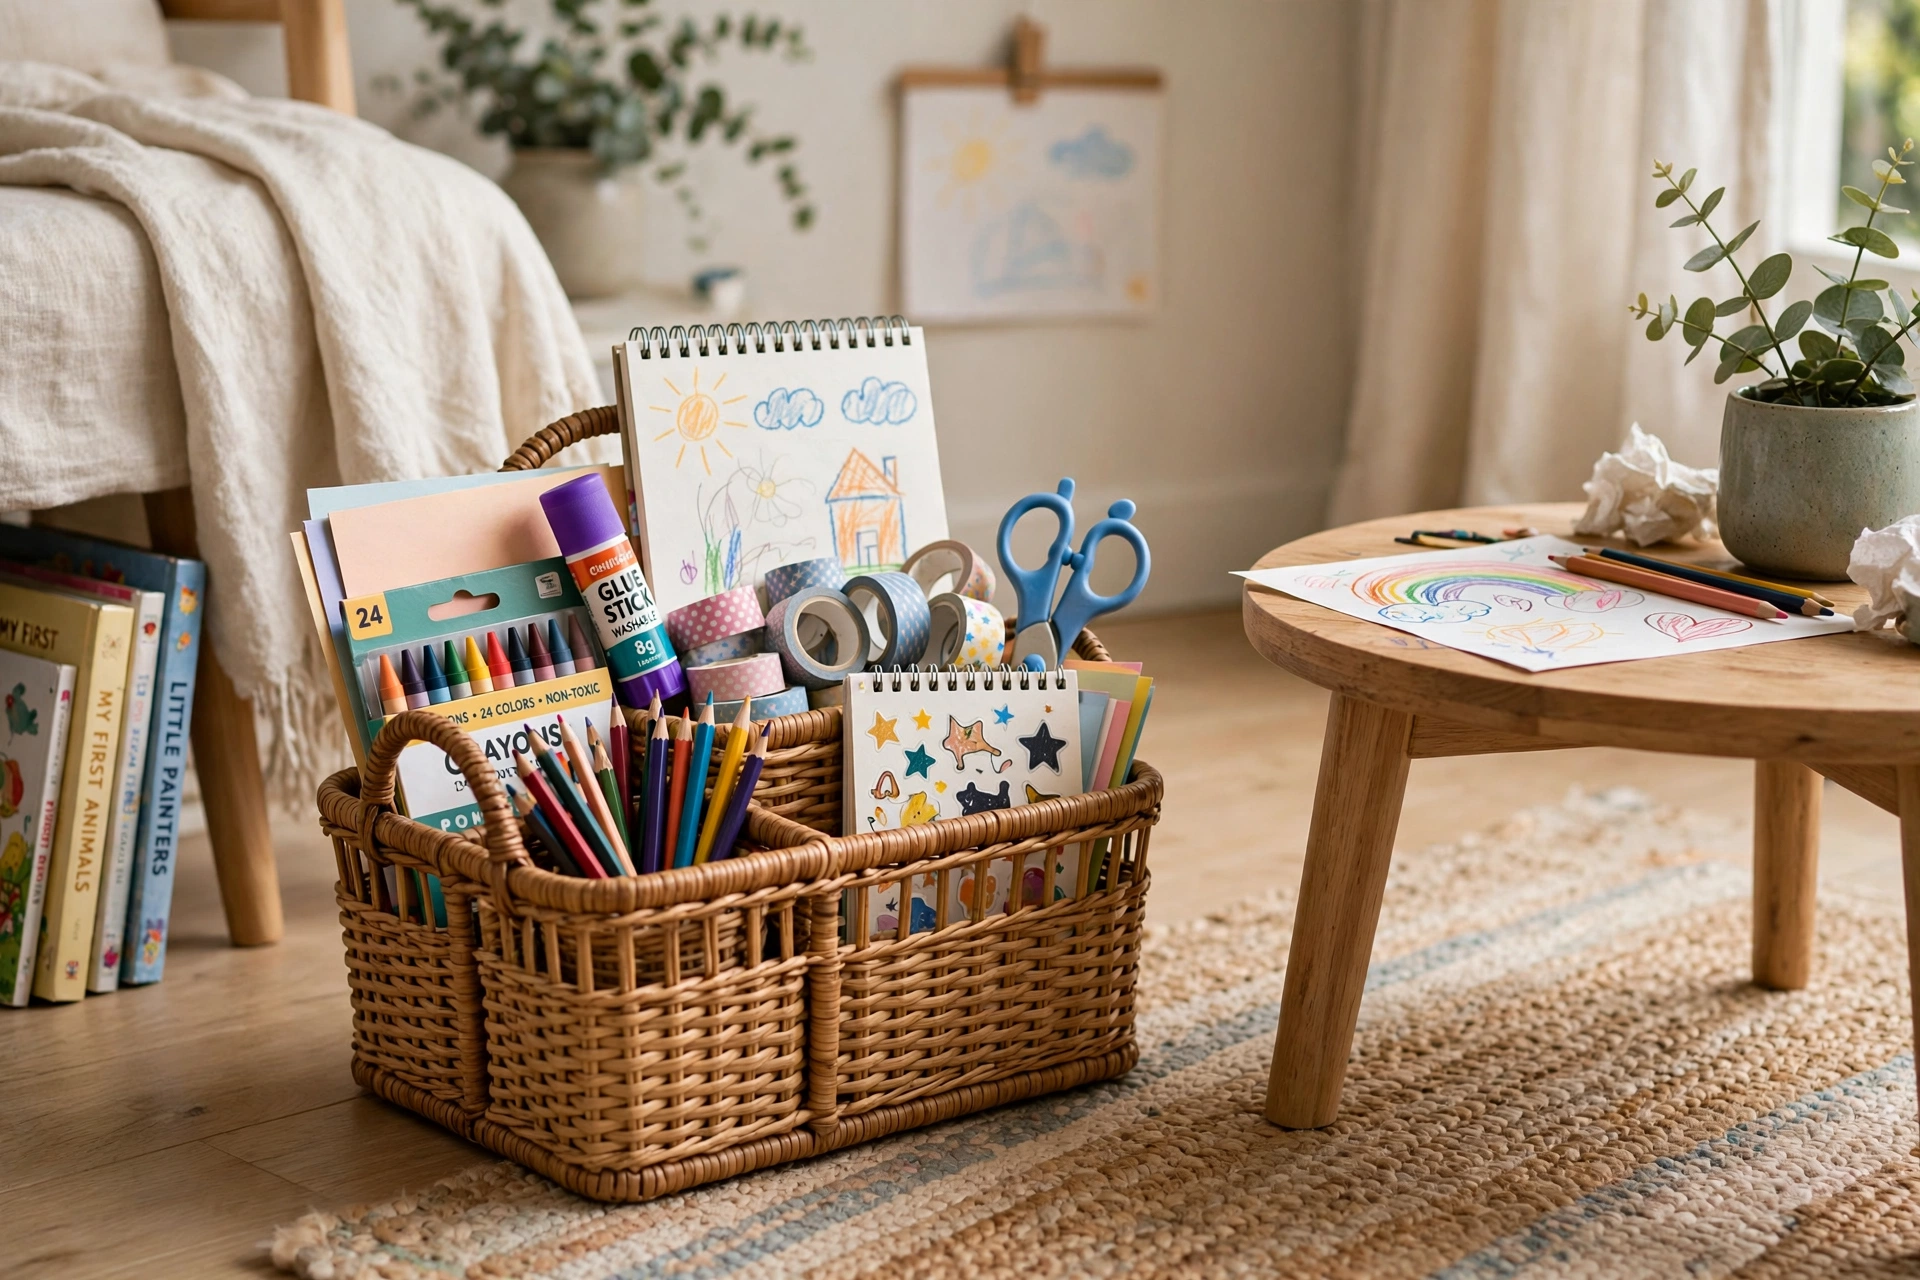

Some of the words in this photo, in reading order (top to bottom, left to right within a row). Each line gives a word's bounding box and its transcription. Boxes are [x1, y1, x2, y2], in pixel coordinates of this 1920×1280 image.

[598, 569, 643, 601] GLUE
[356, 605, 383, 628] 24
[604, 587, 653, 623] STICK
[611, 610, 657, 638] WASHABLE
[634, 640, 656, 655] 8g
[96, 690, 113, 722] MY
[165, 681, 187, 756] LITTLE
[480, 706, 493, 719] 24
[495, 697, 535, 716] COLORS
[545, 682, 601, 705] NON-TOXIC
[88, 731, 109, 789] FIRST
[152, 767, 178, 876] PAINTERS
[75, 798, 99, 892] ANIMALS
